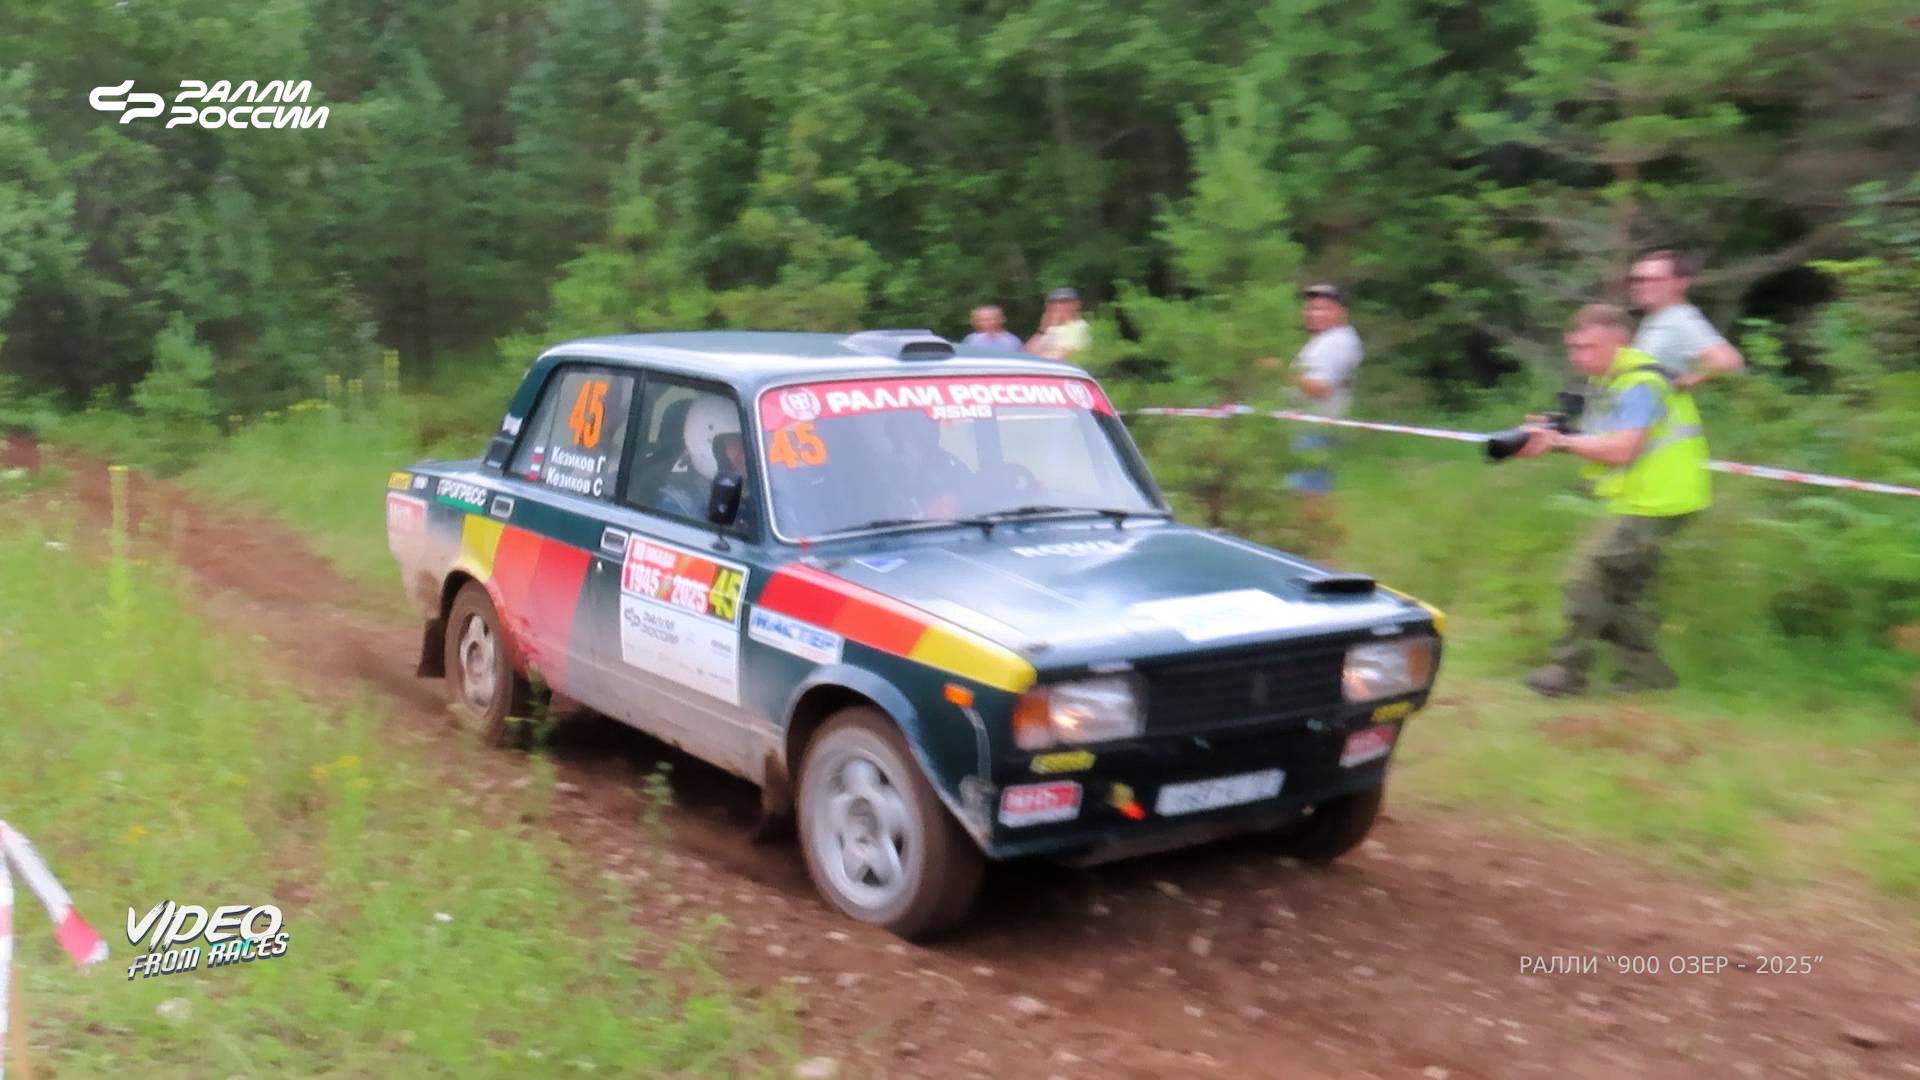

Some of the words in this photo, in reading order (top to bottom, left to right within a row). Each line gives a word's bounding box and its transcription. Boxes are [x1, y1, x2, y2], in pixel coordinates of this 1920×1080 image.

[568, 379, 608, 449] 45
[826, 385, 944, 413] РАЛЛИ
[948, 383, 1068, 405] РОССИИ
[550, 446, 596, 472] Кезиков
[596, 455, 606, 474] Г
[768, 422, 830, 470] 45
[545, 467, 591, 494] Кезиков
[593, 477, 604, 497] С
[708, 568, 742, 620] 45
